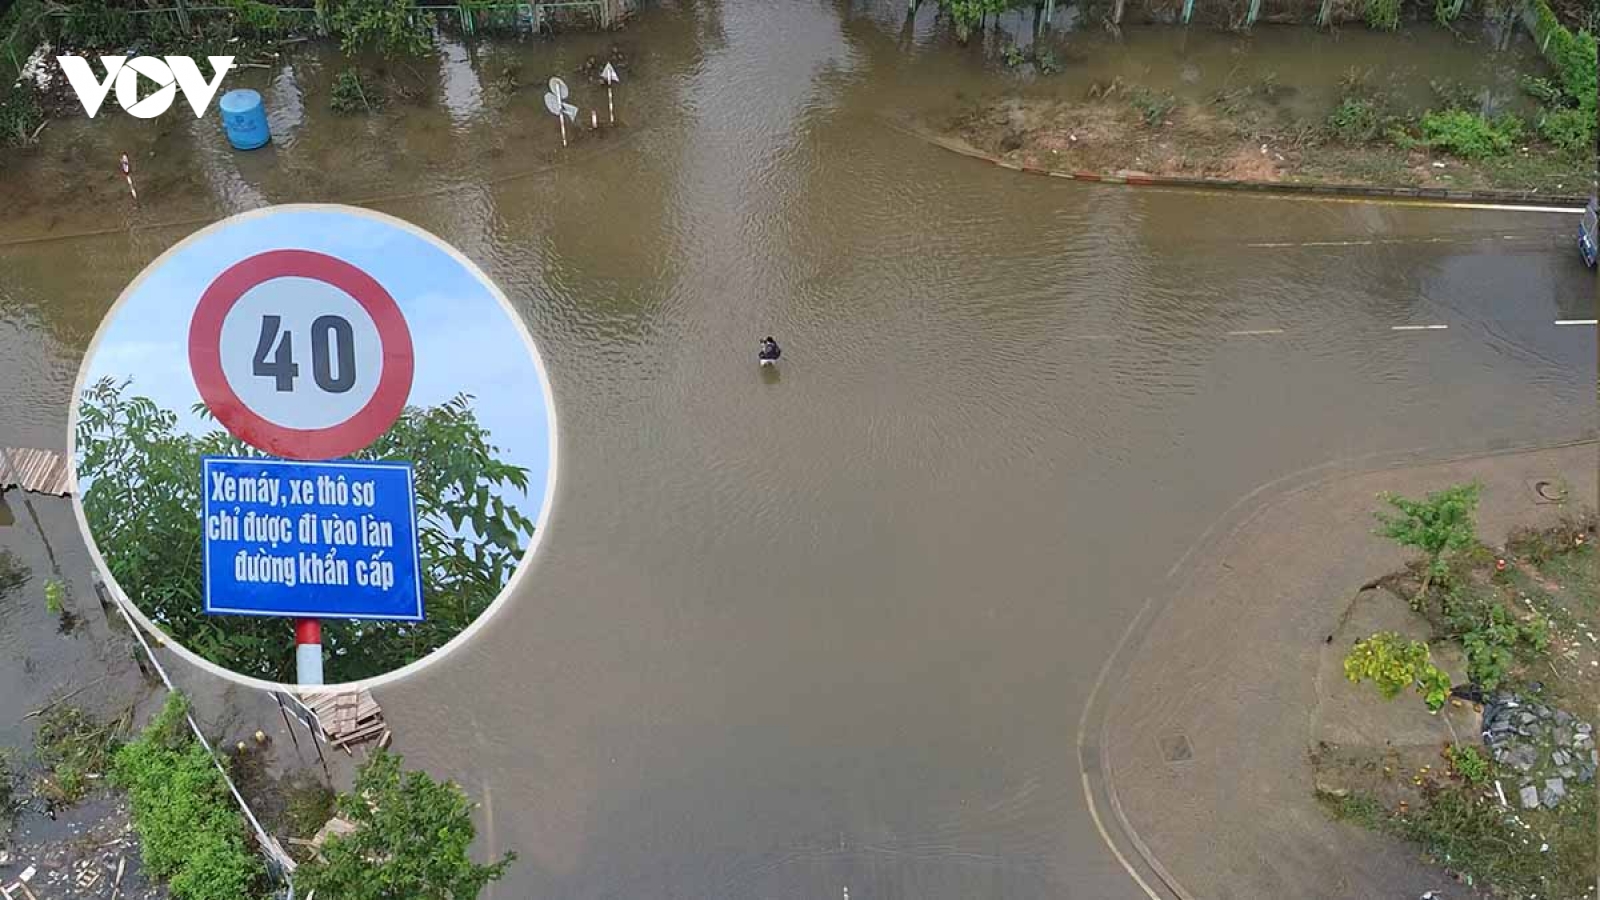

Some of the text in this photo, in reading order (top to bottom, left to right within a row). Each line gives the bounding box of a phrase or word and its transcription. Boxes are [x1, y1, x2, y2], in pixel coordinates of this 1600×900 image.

[252, 314, 356, 394] 40
[211, 471, 376, 507] Xe máy, xe thô sơ
[208, 506, 393, 548] chỉ được đi vào làn
[235, 547, 395, 591] đường khẩn cấp
